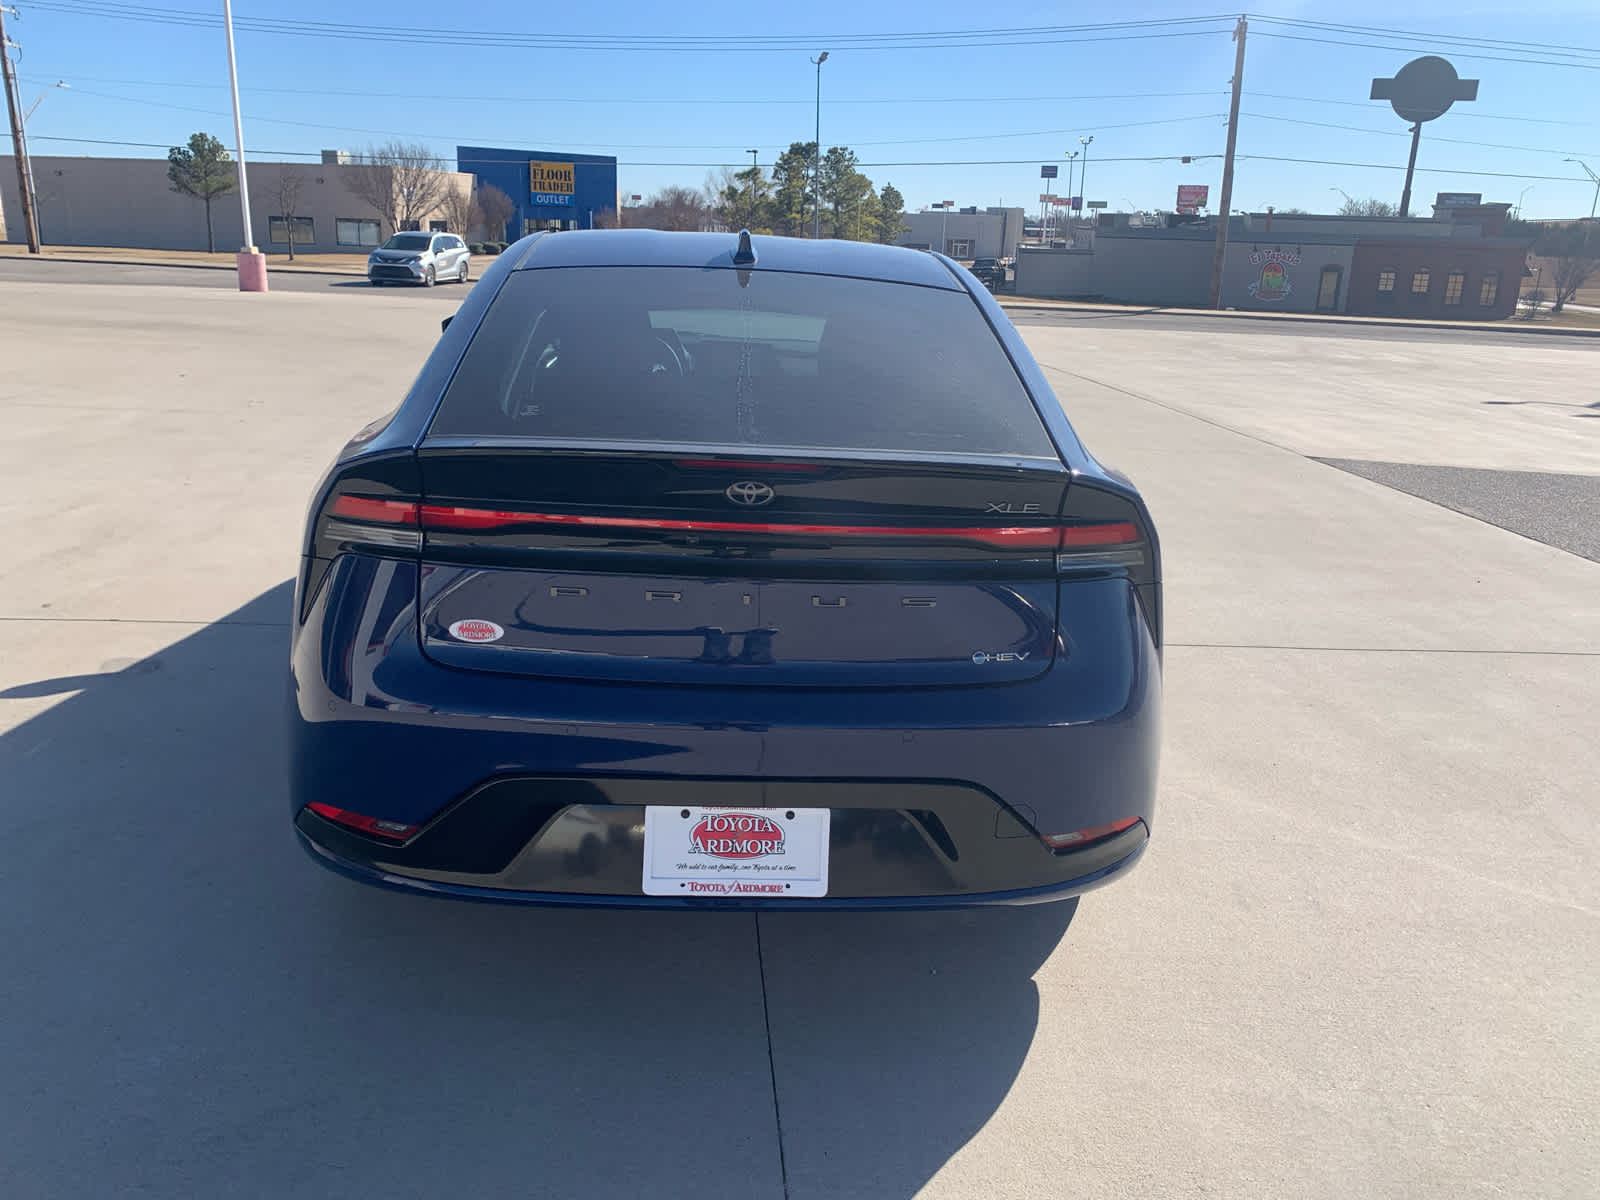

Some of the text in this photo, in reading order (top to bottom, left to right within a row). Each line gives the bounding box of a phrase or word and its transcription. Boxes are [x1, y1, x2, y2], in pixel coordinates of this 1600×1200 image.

[532, 167, 572, 181] FLOOR
[532, 181, 574, 193] TRADER
[536, 194, 570, 204] OUTLET
[984, 502, 1041, 513] XLE
[550, 586, 938, 608] PRIUS
[986, 651, 1031, 662] HEV
[701, 814, 776, 833] TOYOTA
[688, 834, 785, 854] ARDMORE
[688, 882, 726, 892] TOYOTA
[734, 883, 784, 893] ARDMORE
